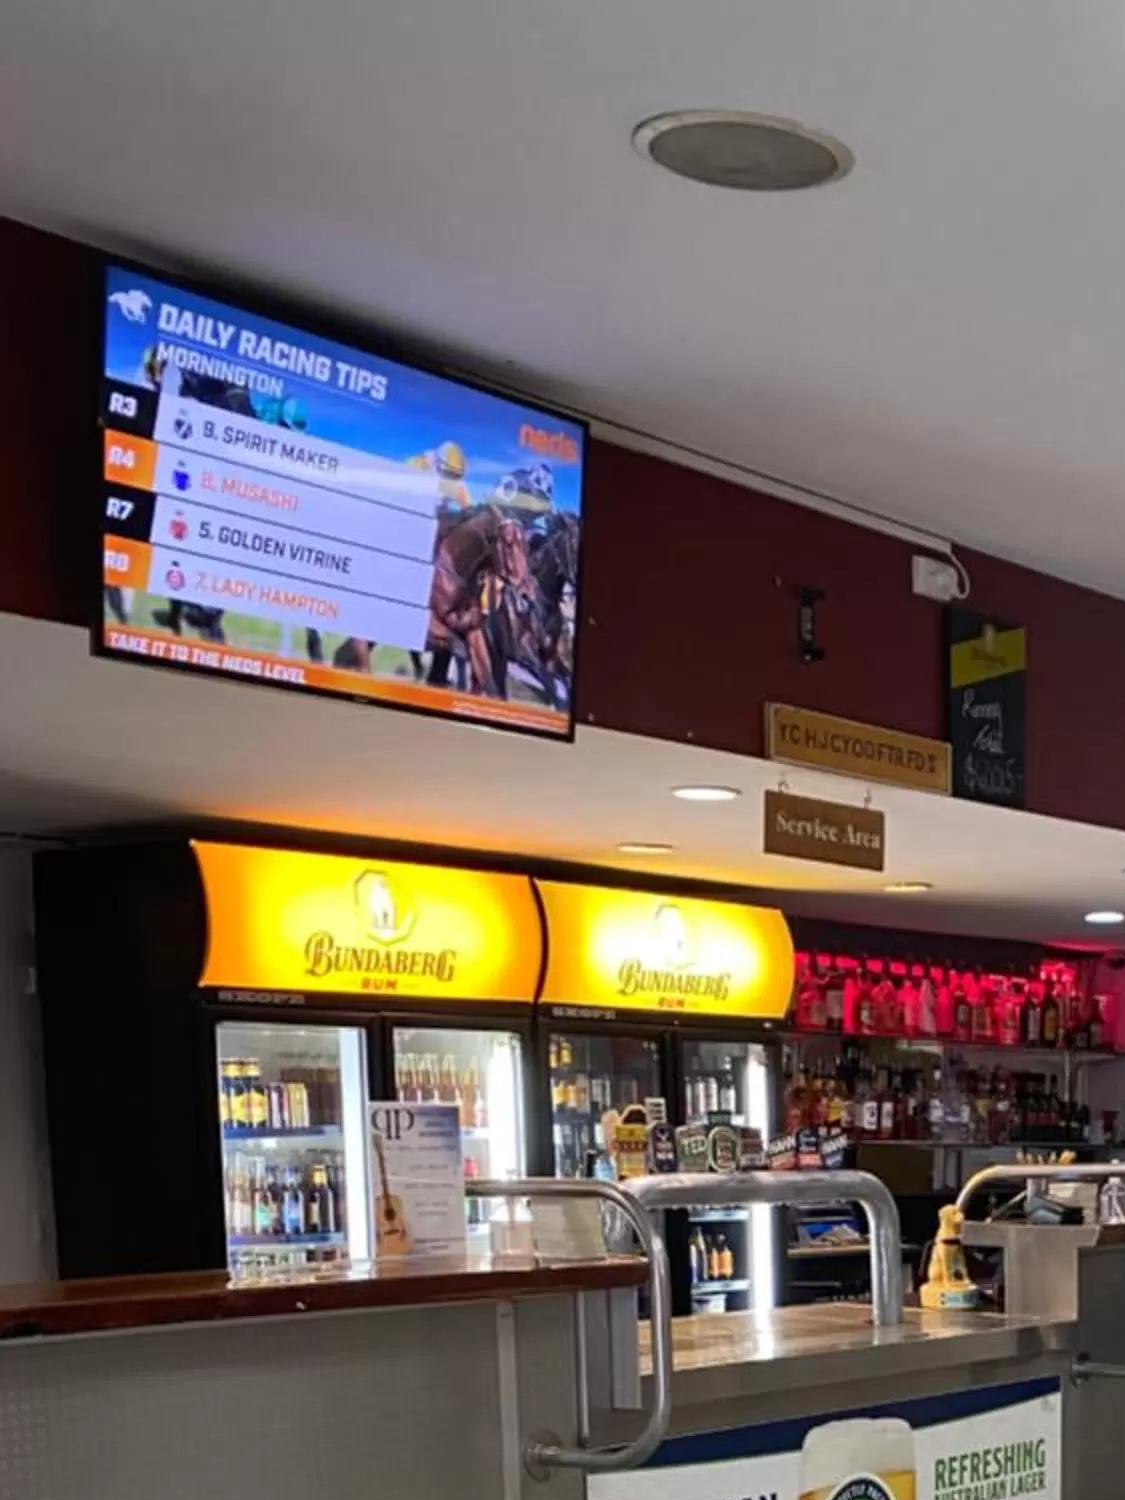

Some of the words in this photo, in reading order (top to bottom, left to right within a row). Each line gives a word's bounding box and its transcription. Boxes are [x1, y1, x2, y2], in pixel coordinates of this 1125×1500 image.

[157, 342, 284, 398] MORNINGTON
[158, 303, 236, 349] DAILY
[238, 329, 333, 382] RACING
[335, 363, 388, 400] TIPS
[109, 392, 138, 417] R3
[222, 426, 277, 456] SPIRIT
[280, 442, 339, 474] MAKER
[106, 497, 134, 520] R7
[199, 521, 215, 542] 5.
[218, 526, 286, 558] GOLDEN
[290, 543, 352, 575] VITRINE
[212, 575, 256, 601] LADY
[259, 585, 339, 619] HAMPTON
[109, 632, 149, 652] TAKE
[151, 639, 168, 657] IT
[169, 644, 189, 662] TO
[192, 648, 221, 667] THE
[265, 663, 306, 683] LEVEL
[776, 811, 838, 842] Service
[843, 823, 881, 849] Area
[361, 976, 399, 991] RUM
[934, 1437, 1046, 1491] REFRESHING
[1009, 1472, 1046, 1497] LAGER
